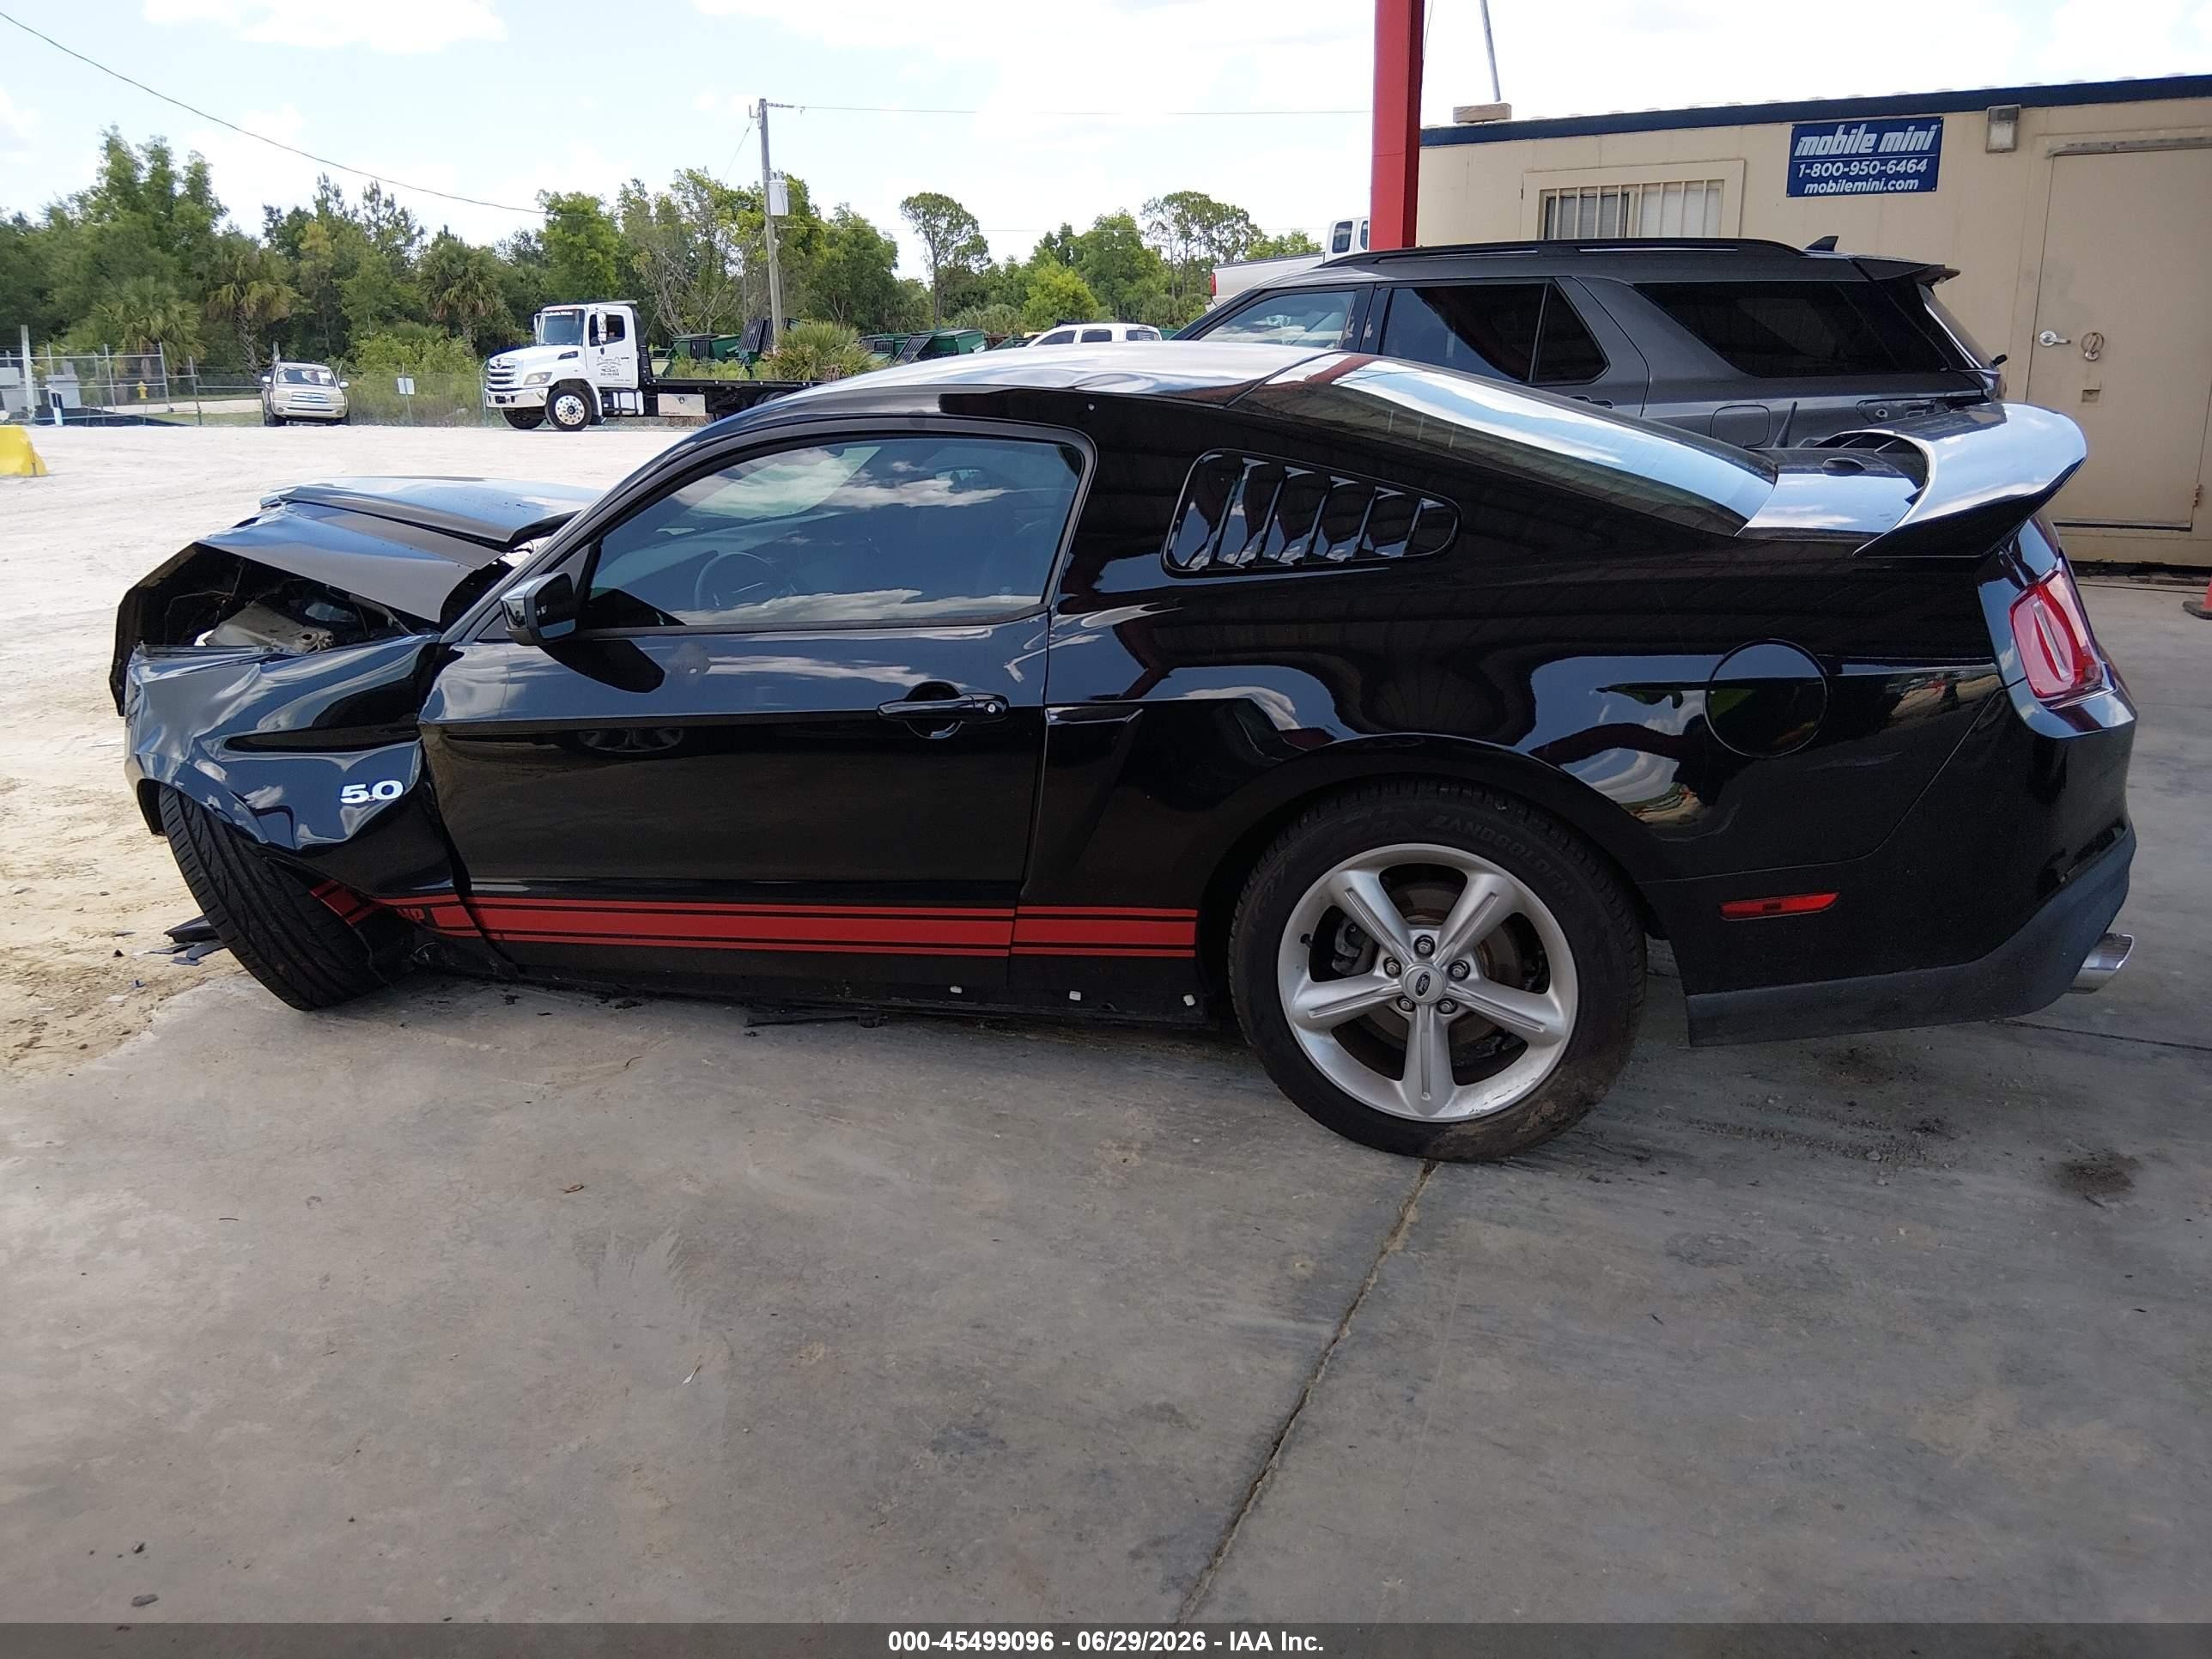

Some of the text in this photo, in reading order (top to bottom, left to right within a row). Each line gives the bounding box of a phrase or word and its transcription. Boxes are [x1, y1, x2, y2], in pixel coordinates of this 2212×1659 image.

[1794, 124, 1937, 156] mobile mini
[1798, 159, 1928, 178] 1-800-950-6464
[1804, 178, 1919, 194] mobilemini.com
[340, 781, 403, 804] 5.0
